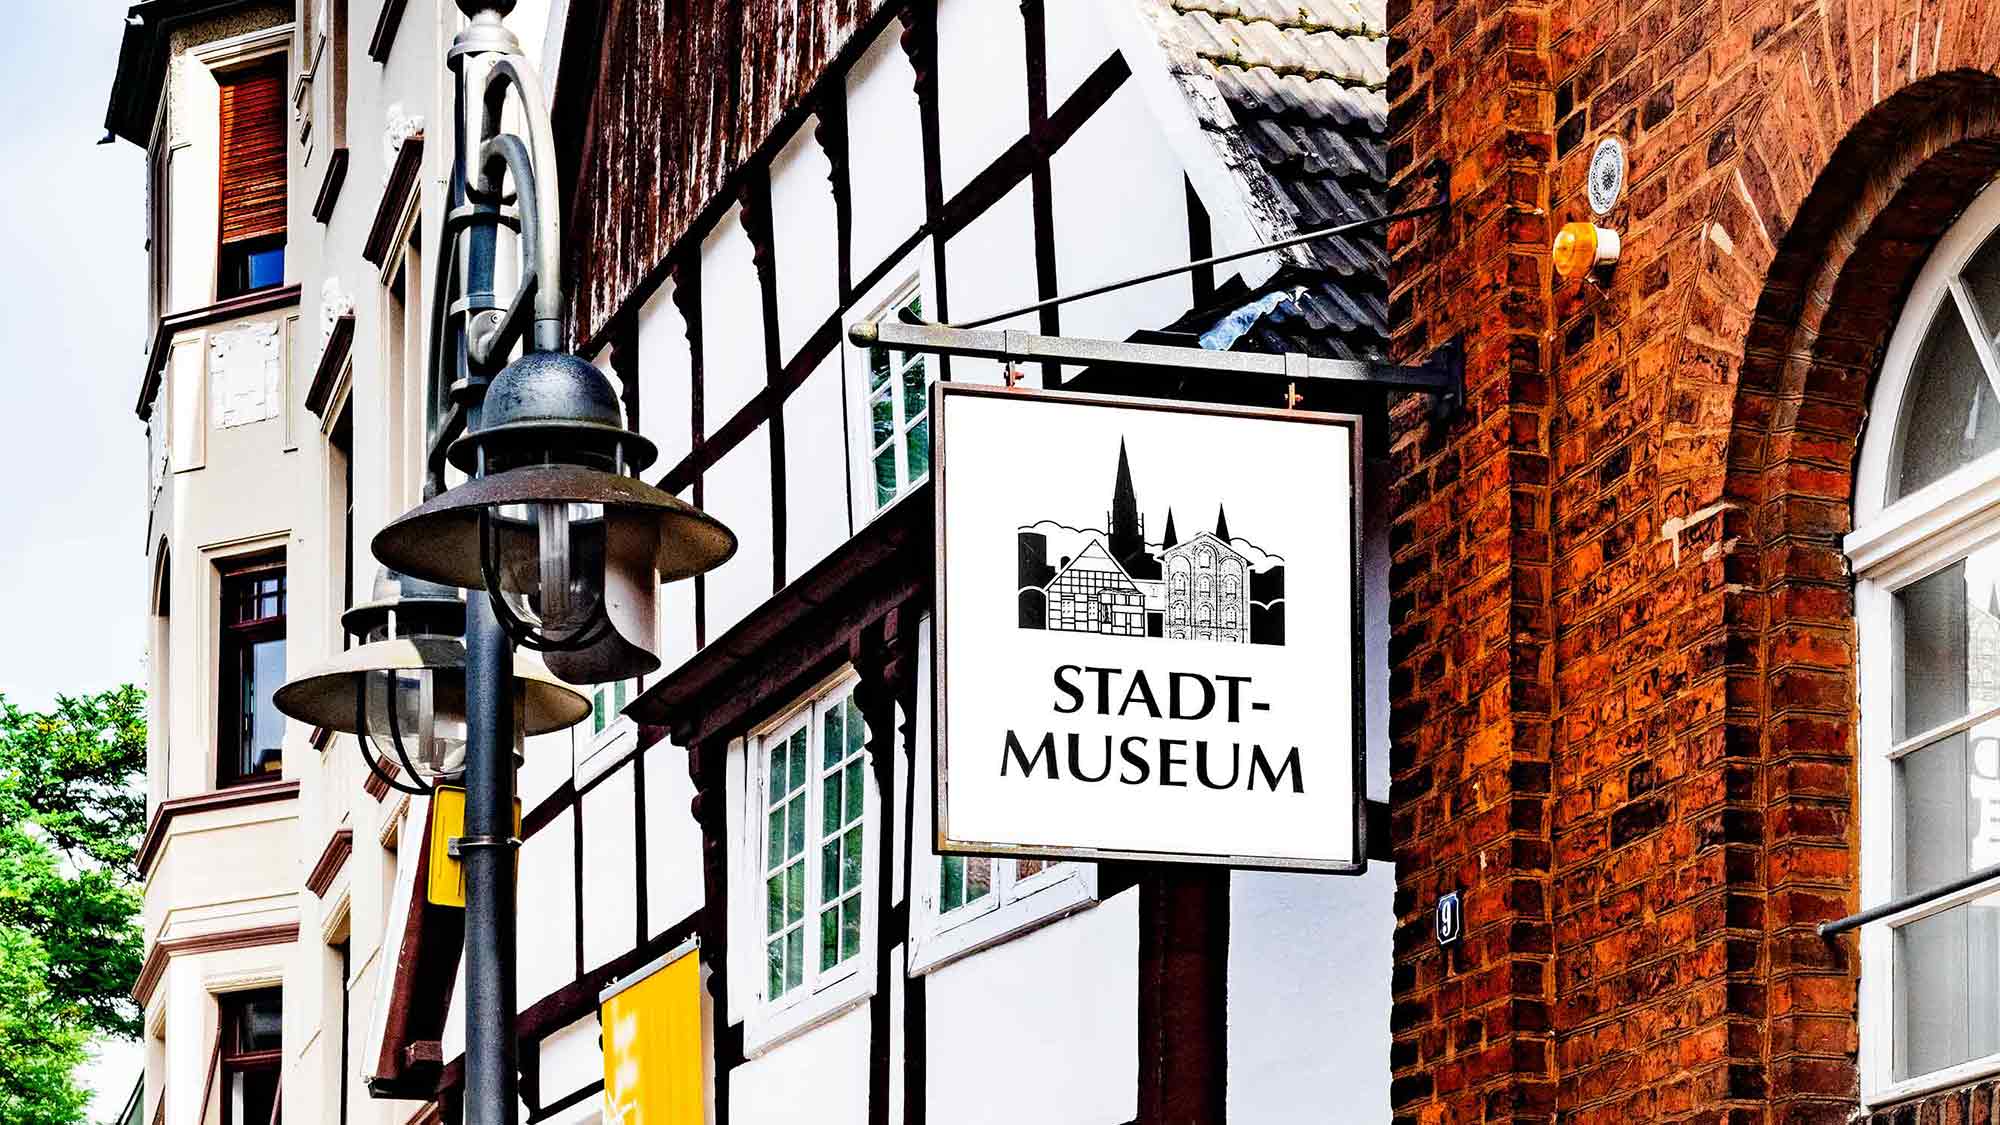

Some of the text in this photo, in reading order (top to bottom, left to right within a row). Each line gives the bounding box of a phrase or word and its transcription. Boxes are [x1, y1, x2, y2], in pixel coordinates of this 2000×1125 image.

[1053, 665, 1270, 723] STADT-
[1000, 729, 1305, 794] MUSEUM
[1441, 901, 1452, 937] 9
